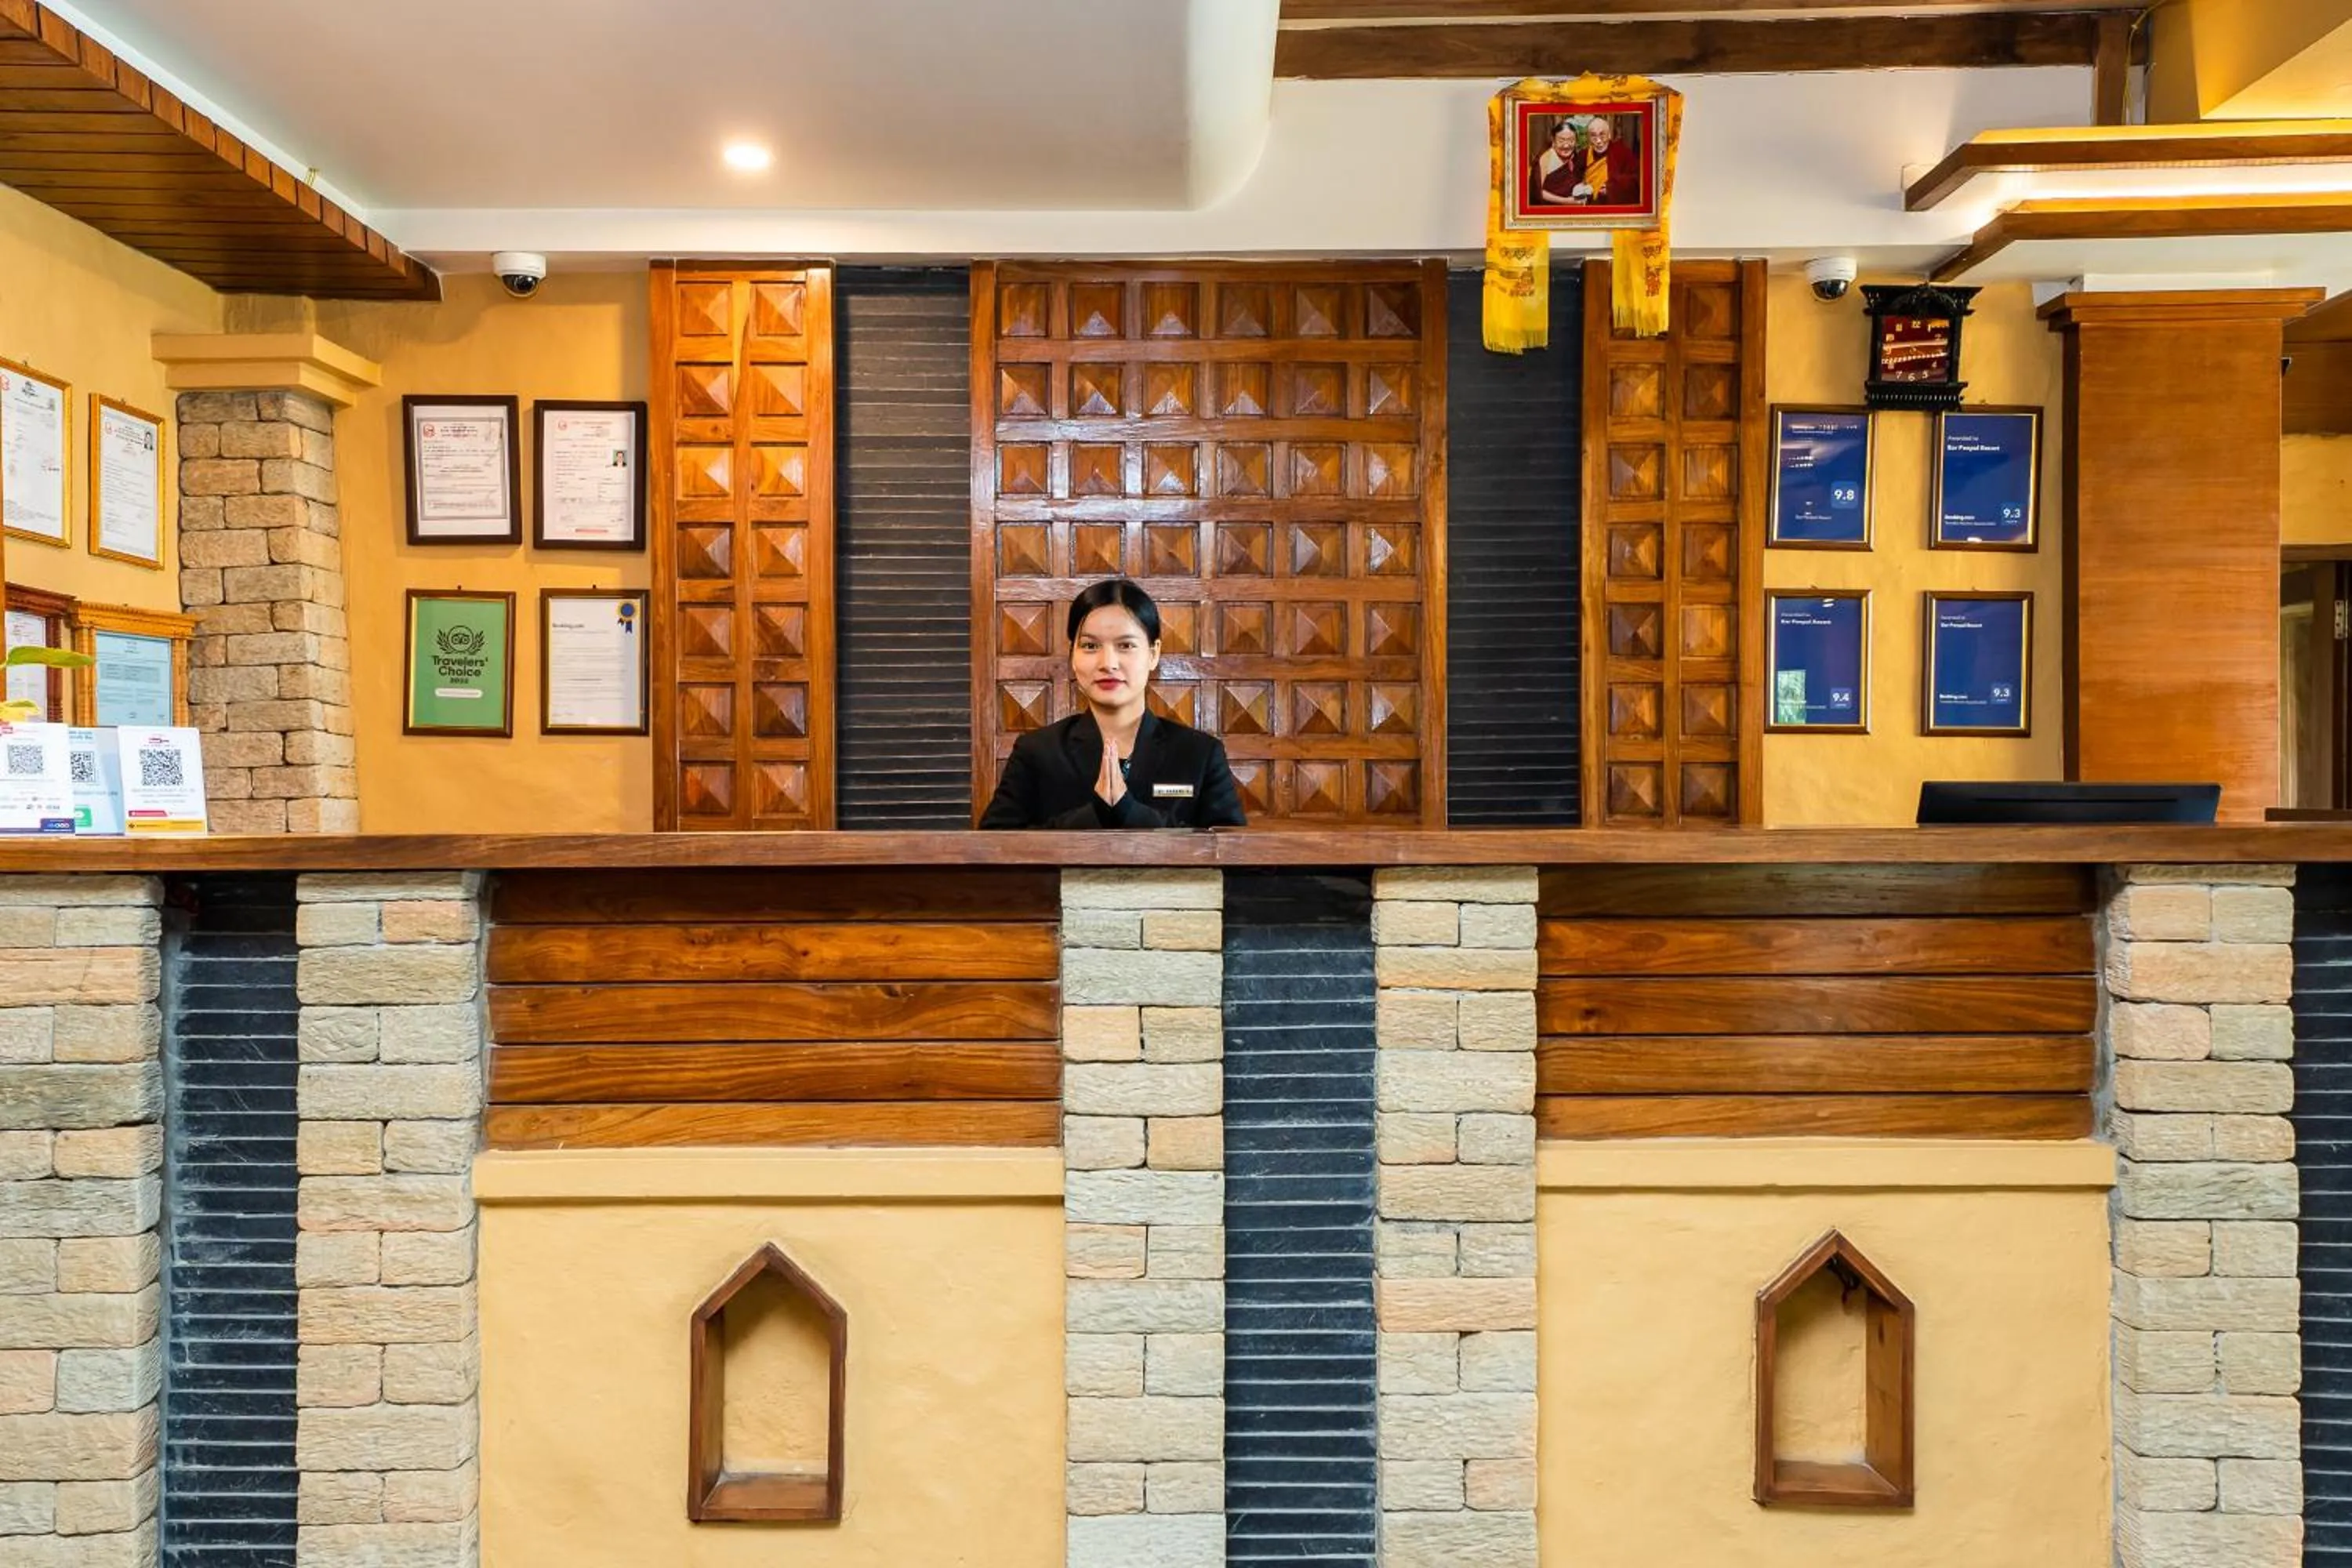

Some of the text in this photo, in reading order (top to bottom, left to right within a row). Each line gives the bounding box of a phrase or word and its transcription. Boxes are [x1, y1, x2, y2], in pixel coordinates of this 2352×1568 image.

[1835, 488, 1854, 501] 9.8
[2003, 507, 2020, 518] 9.3
[438, 666, 482, 677] Choice
[1832, 692, 1850, 702] 9.4
[1994, 688, 2010, 697] 9.3
